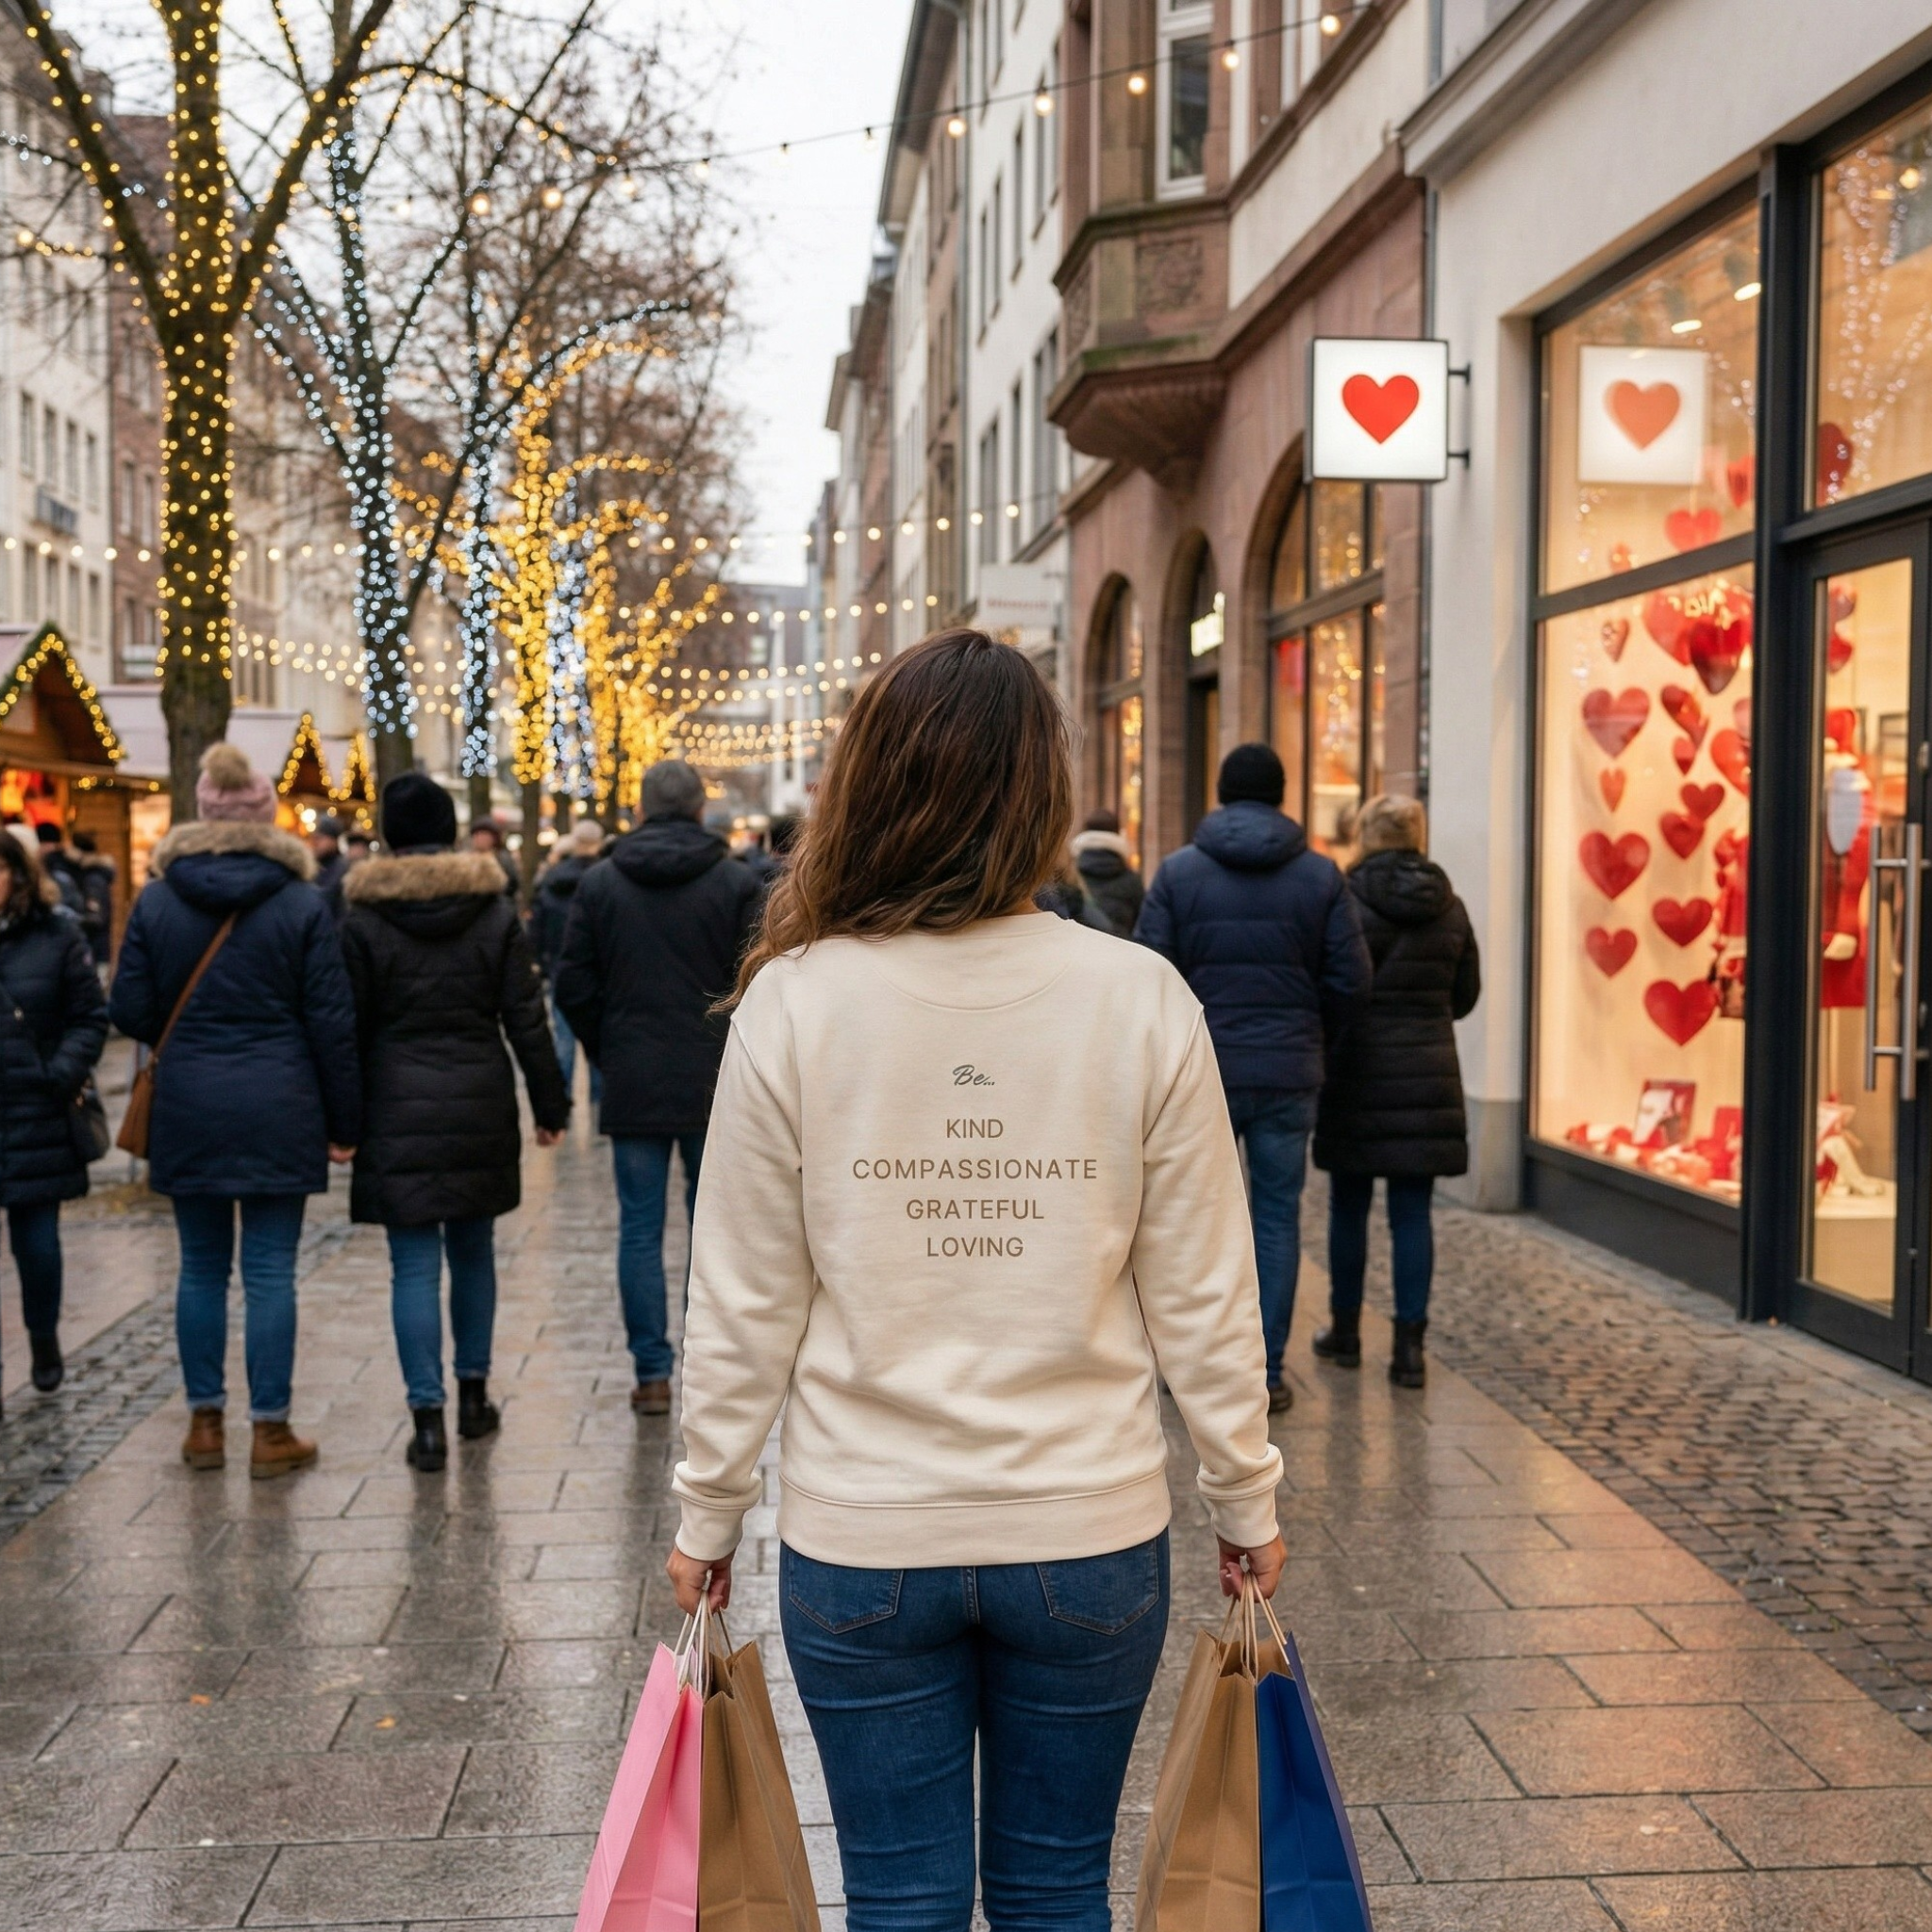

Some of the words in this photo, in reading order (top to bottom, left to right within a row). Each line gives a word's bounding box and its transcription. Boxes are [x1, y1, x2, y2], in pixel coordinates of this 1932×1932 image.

[952, 1064, 995, 1086] Be...
[946, 1119, 1004, 1139] KIND
[853, 1159, 1097, 1179] COMPASSIONATE
[907, 1199, 1044, 1220] GRATEFUL
[927, 1237, 1024, 1257] LOVING
